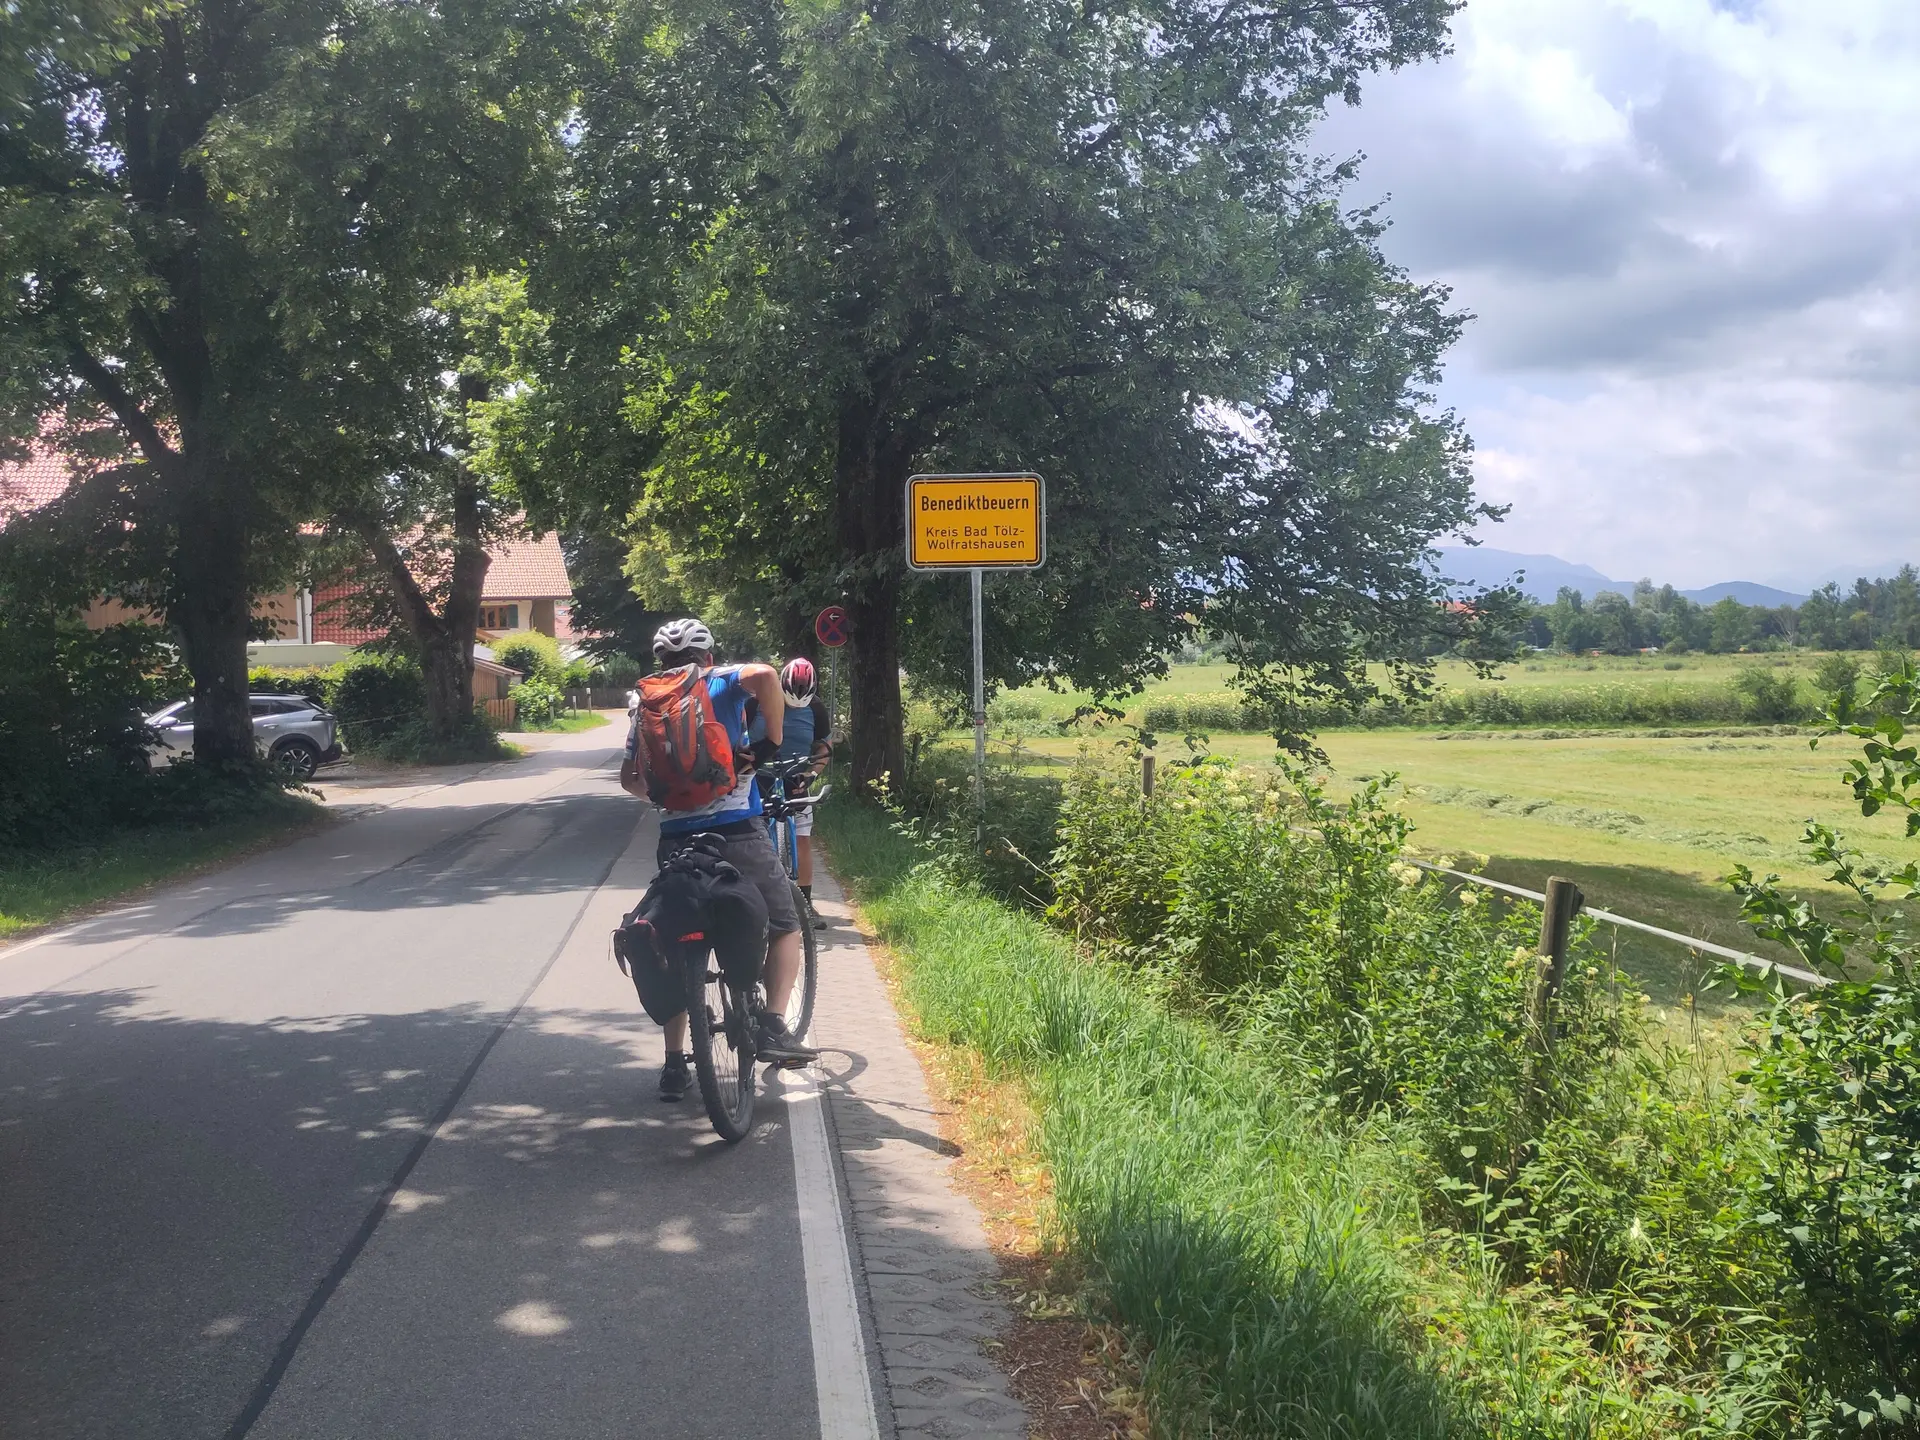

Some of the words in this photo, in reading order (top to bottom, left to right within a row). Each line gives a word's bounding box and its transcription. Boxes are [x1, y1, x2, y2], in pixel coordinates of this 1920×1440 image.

[921, 495, 1029, 511] Benediktbeuern
[926, 526, 958, 537] Kreis
[964, 526, 987, 537] Bad
[993, 525, 1025, 536] Tölz-
[927, 539, 1025, 550] Wolfratshausen
